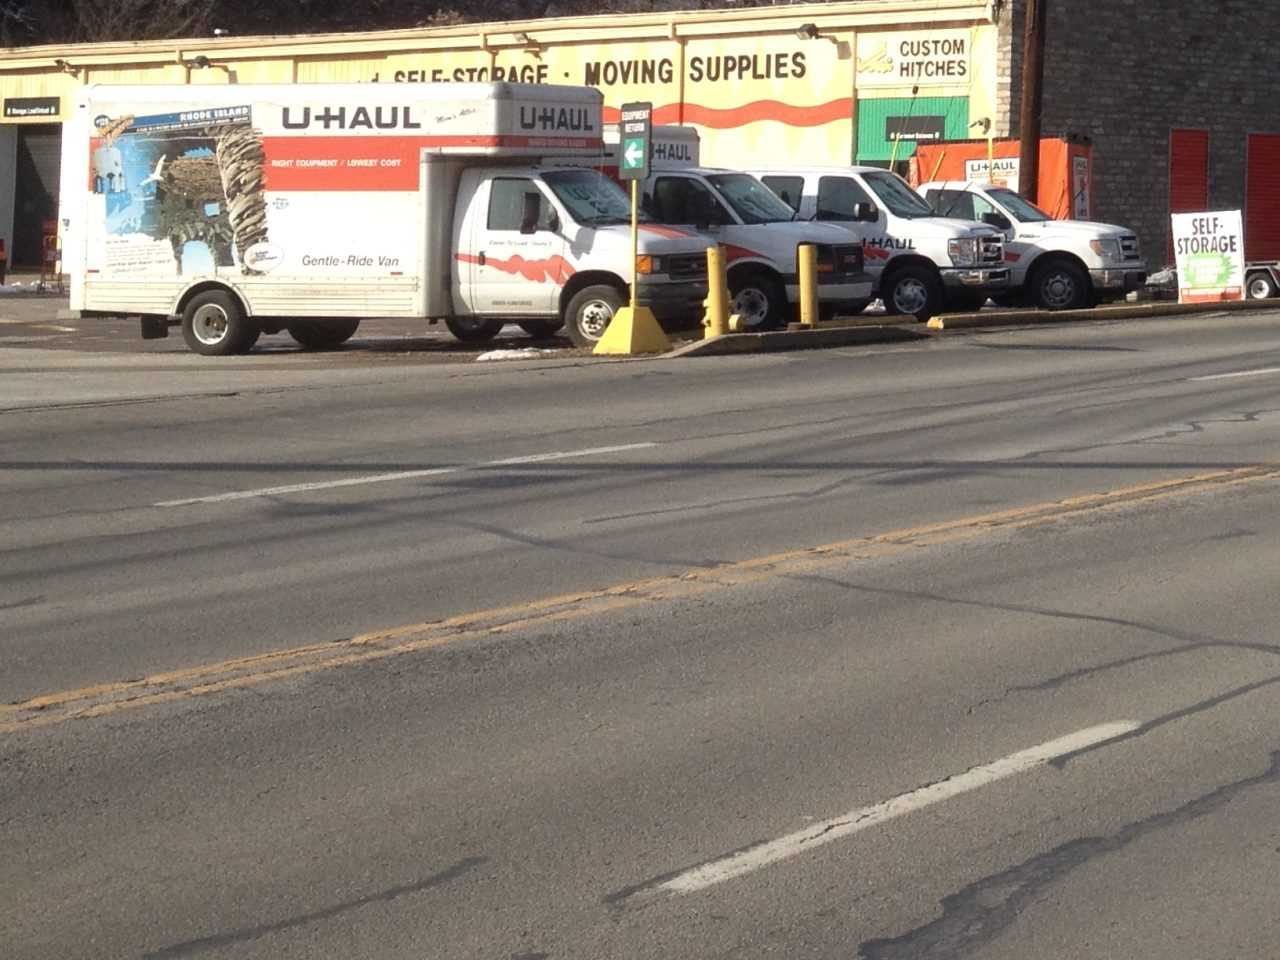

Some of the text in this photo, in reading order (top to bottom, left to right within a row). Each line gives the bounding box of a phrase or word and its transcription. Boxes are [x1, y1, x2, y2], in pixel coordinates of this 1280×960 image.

[900, 39, 965, 56] CUSTOM
[585, 58, 673, 86] MOVING
[689, 51, 806, 82] SUPPLIES
[900, 60, 967, 77] HITCHES
[179, 106, 249, 122] RHODE ISLAND
[282, 106, 421, 129] U-HAUL
[520, 106, 593, 131] U-HAUL
[650, 143, 692, 161] -HAUL
[296, 159, 338, 167] EQUIPMENT
[346, 159, 378, 167] LOWEST
[380, 159, 401, 167] COST
[1178, 235, 1237, 255] STORAGE
[377, 256, 400, 267] Van
